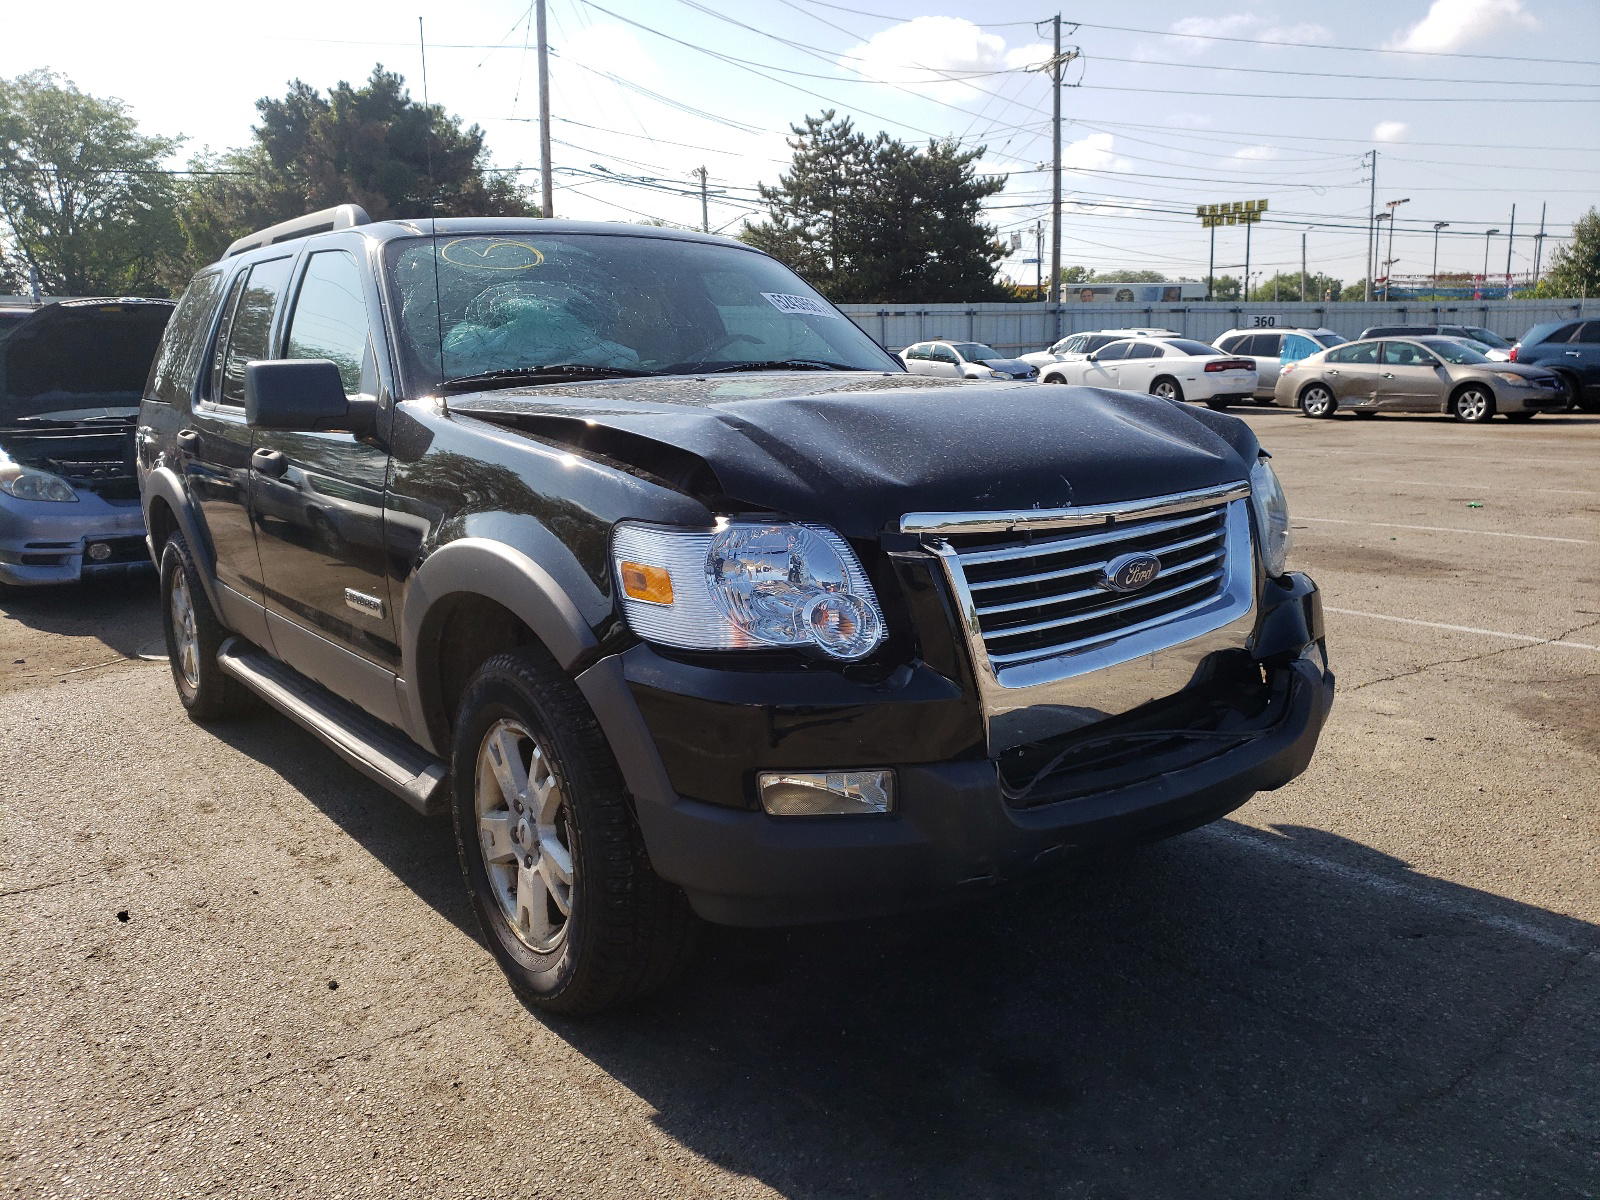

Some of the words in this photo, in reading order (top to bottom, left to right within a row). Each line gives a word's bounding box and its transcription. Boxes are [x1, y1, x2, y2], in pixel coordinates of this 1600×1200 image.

[1197, 200, 1267, 215] WAFFLE
[1203, 213, 1261, 227] HOUSE
[1253, 316, 1275, 327] 360
[1125, 561, 1154, 585] Ford
